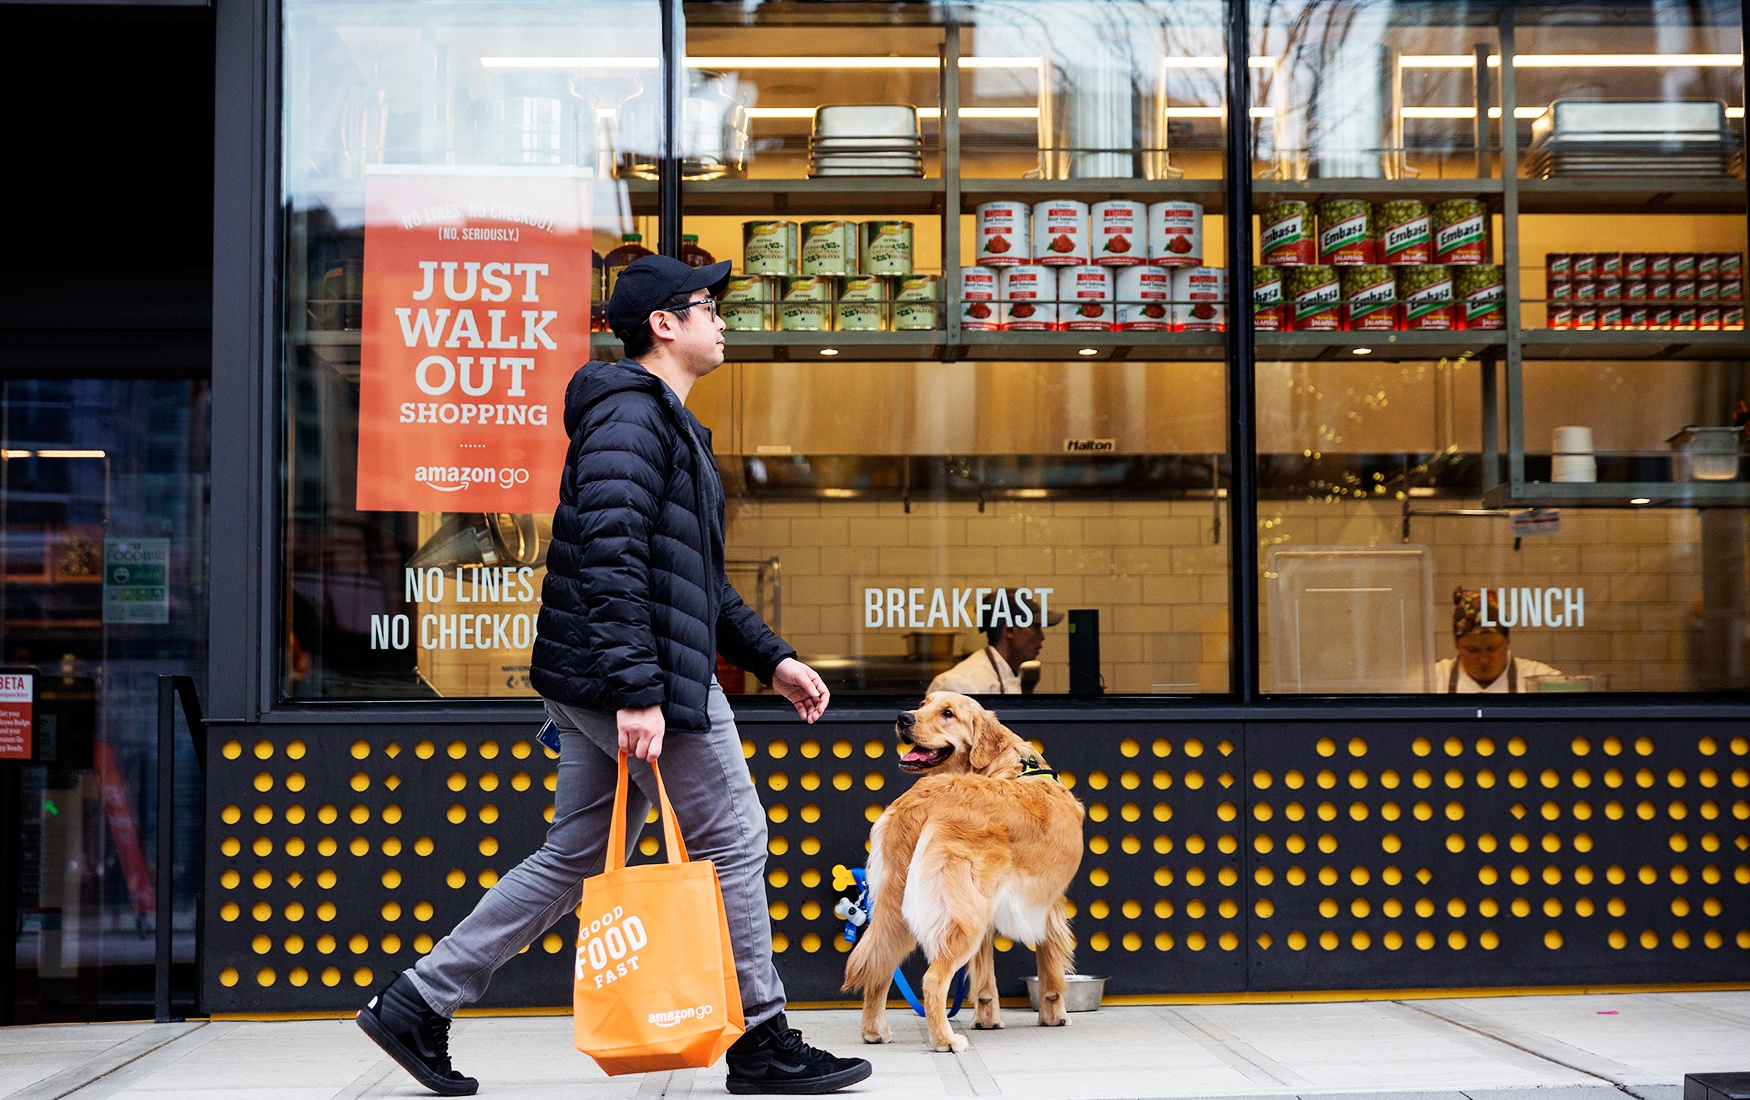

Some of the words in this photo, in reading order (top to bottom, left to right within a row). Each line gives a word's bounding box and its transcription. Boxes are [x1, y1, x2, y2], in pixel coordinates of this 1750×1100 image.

[401, 210, 422, 230] NO
[424, 203, 464, 223] LINES.
[469, 202, 487, 218] NO
[490, 204, 556, 234] CHECKOUT.
[462, 227, 520, 242] SERIOUSLY.)
[1261, 224, 1297, 246] Embasa
[1324, 223, 1363, 246] Embasa
[1390, 224, 1427, 246] Embasa
[1441, 223, 1480, 246] Embasa
[413, 261, 549, 302] JUST
[395, 308, 558, 350] WALK
[415, 355, 534, 396] OUT
[400, 403, 548, 426] SHOPPING
[1068, 440, 1112, 450] Halton
[415, 466, 496, 486] amazon
[499, 467, 530, 489] go
[405, 566, 444, 602] NO
[865, 588, 1054, 628] BREAKFAST
[1480, 587, 1584, 627] LUNCH
[370, 614, 410, 650] NO
[422, 613, 538, 650] CHECKO
[579, 905, 624, 941] GOOD
[575, 915, 648, 981] FOOD
[594, 956, 640, 989] FAST
[648, 1006, 694, 1025] amazon
[695, 1004, 713, 1019] go
